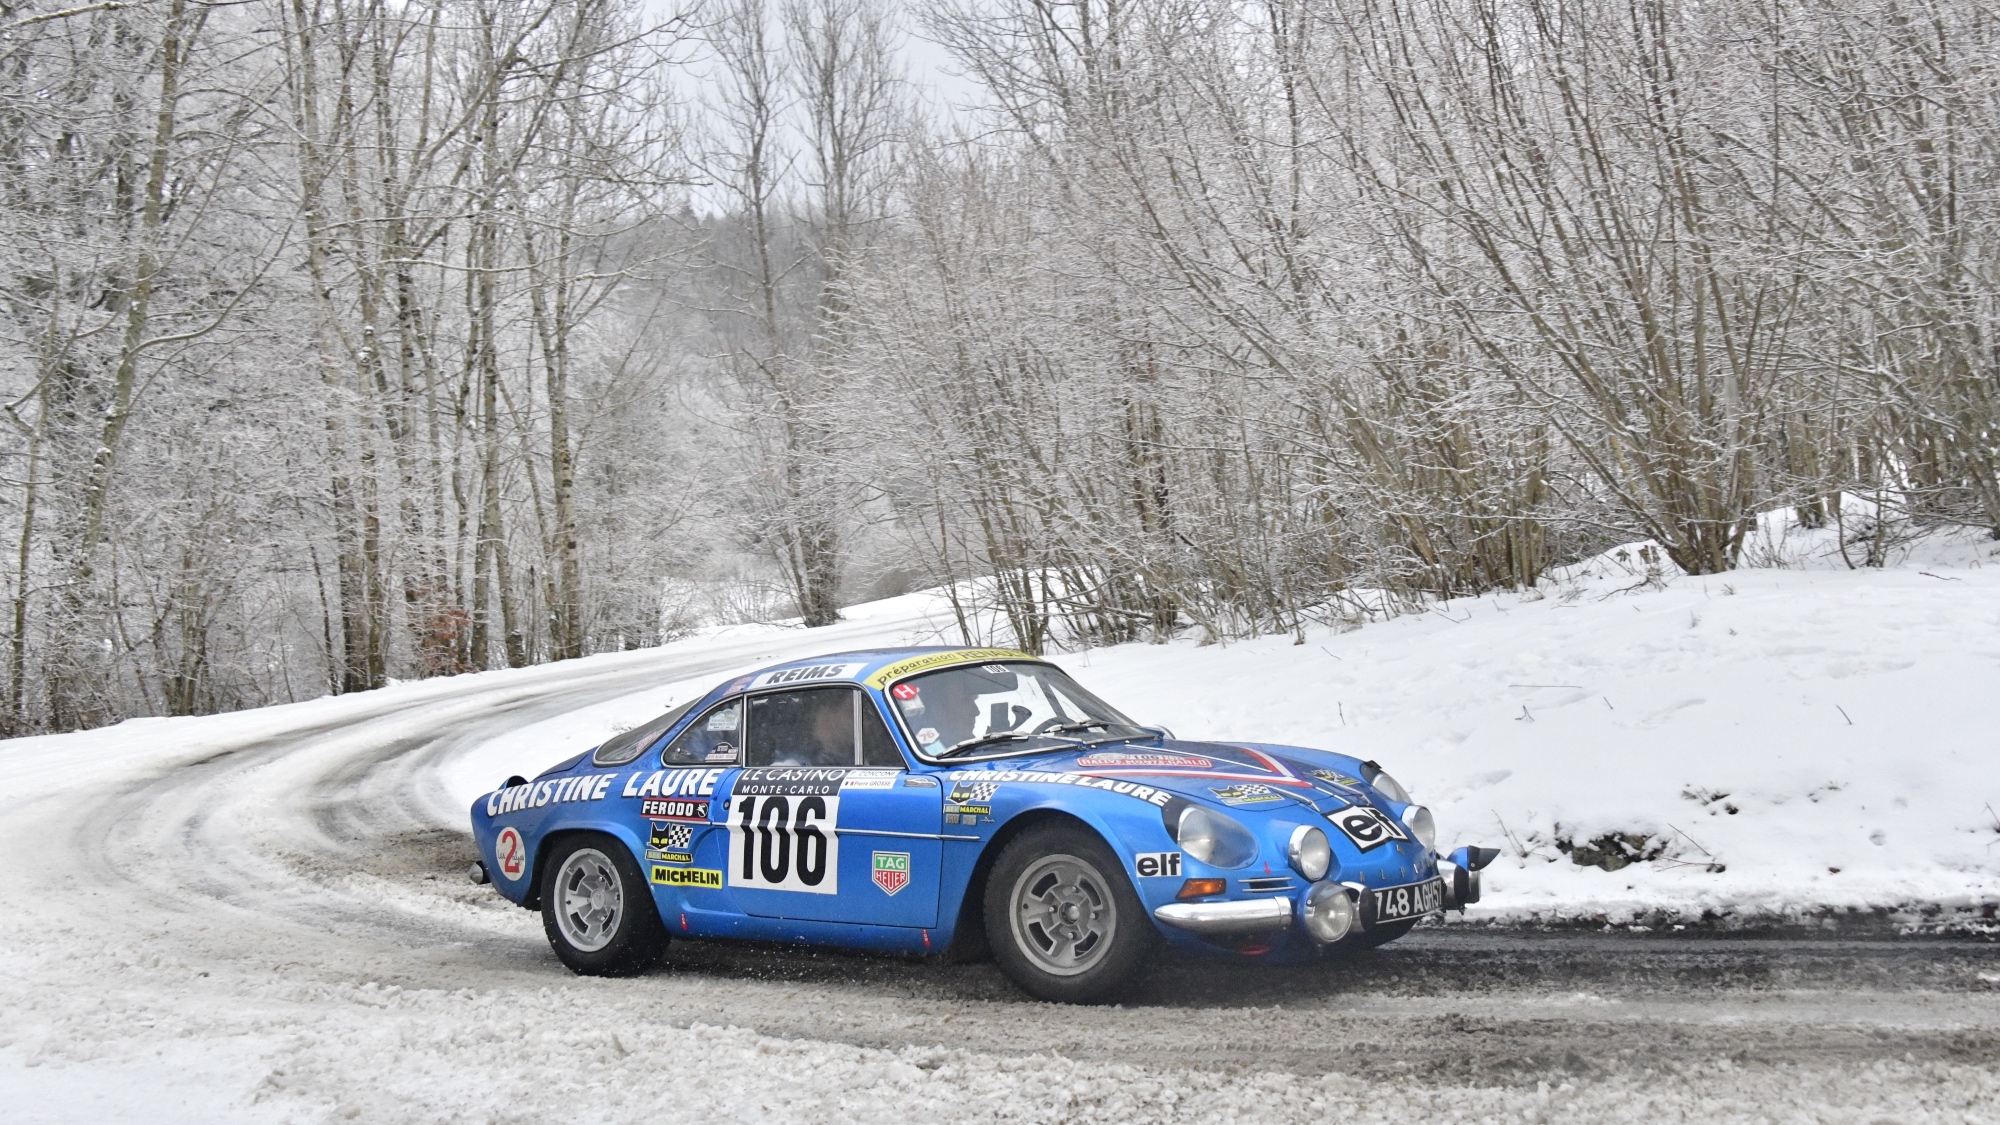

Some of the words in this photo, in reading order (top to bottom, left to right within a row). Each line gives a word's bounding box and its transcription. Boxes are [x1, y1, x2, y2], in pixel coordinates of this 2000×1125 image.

[766, 665, 846, 685] REIMS
[877, 652, 957, 685] préparation
[895, 684, 916, 699] H
[918, 731, 936, 742] 76
[741, 769, 761, 781] LE
[765, 769, 845, 782] CASINO
[486, 774, 618, 817] CHRISTINE
[621, 769, 727, 798] LAURE
[741, 785, 783, 794] MONTE
[789, 786, 830, 794] CARLO
[950, 771, 1073, 786] CHRISTINE
[1071, 773, 1174, 808] LAURE
[641, 801, 694, 817] FERODO
[960, 806, 989, 814] MARCHAL
[1341, 808, 1402, 842] elf
[738, 796, 827, 886] 106
[502, 831, 520, 873] 2
[661, 853, 691, 862] MARCHAL
[876, 856, 905, 870] TAG
[1137, 853, 1180, 876] elf
[655, 868, 719, 885] MICHELIN
[876, 871, 906, 890] HEUER
[1374, 887, 1411, 920] 748
[1413, 879, 1442, 914] AGH57
